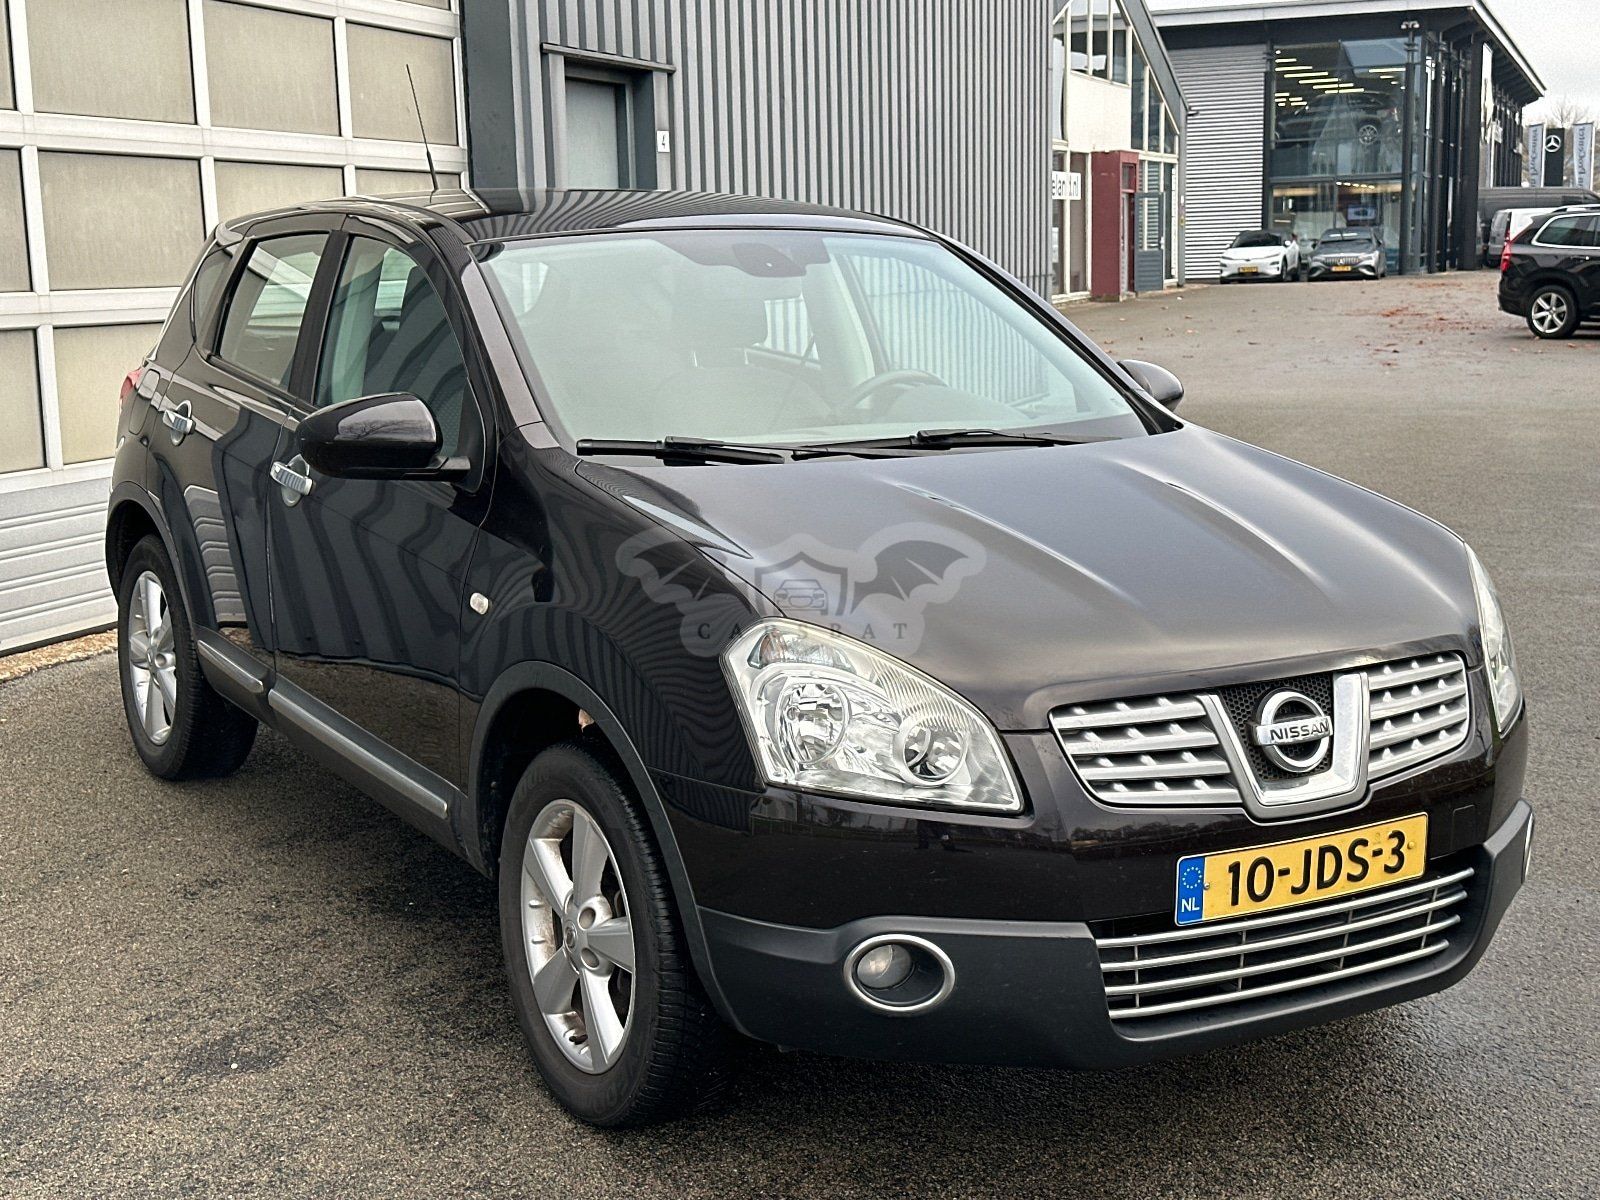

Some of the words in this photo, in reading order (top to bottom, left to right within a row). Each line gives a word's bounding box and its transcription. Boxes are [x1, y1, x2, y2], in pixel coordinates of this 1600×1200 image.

[1270, 717, 1330, 741] NISSAN
[1227, 829, 1406, 907] 10-JDS-3
[1181, 897, 1200, 913] NL
